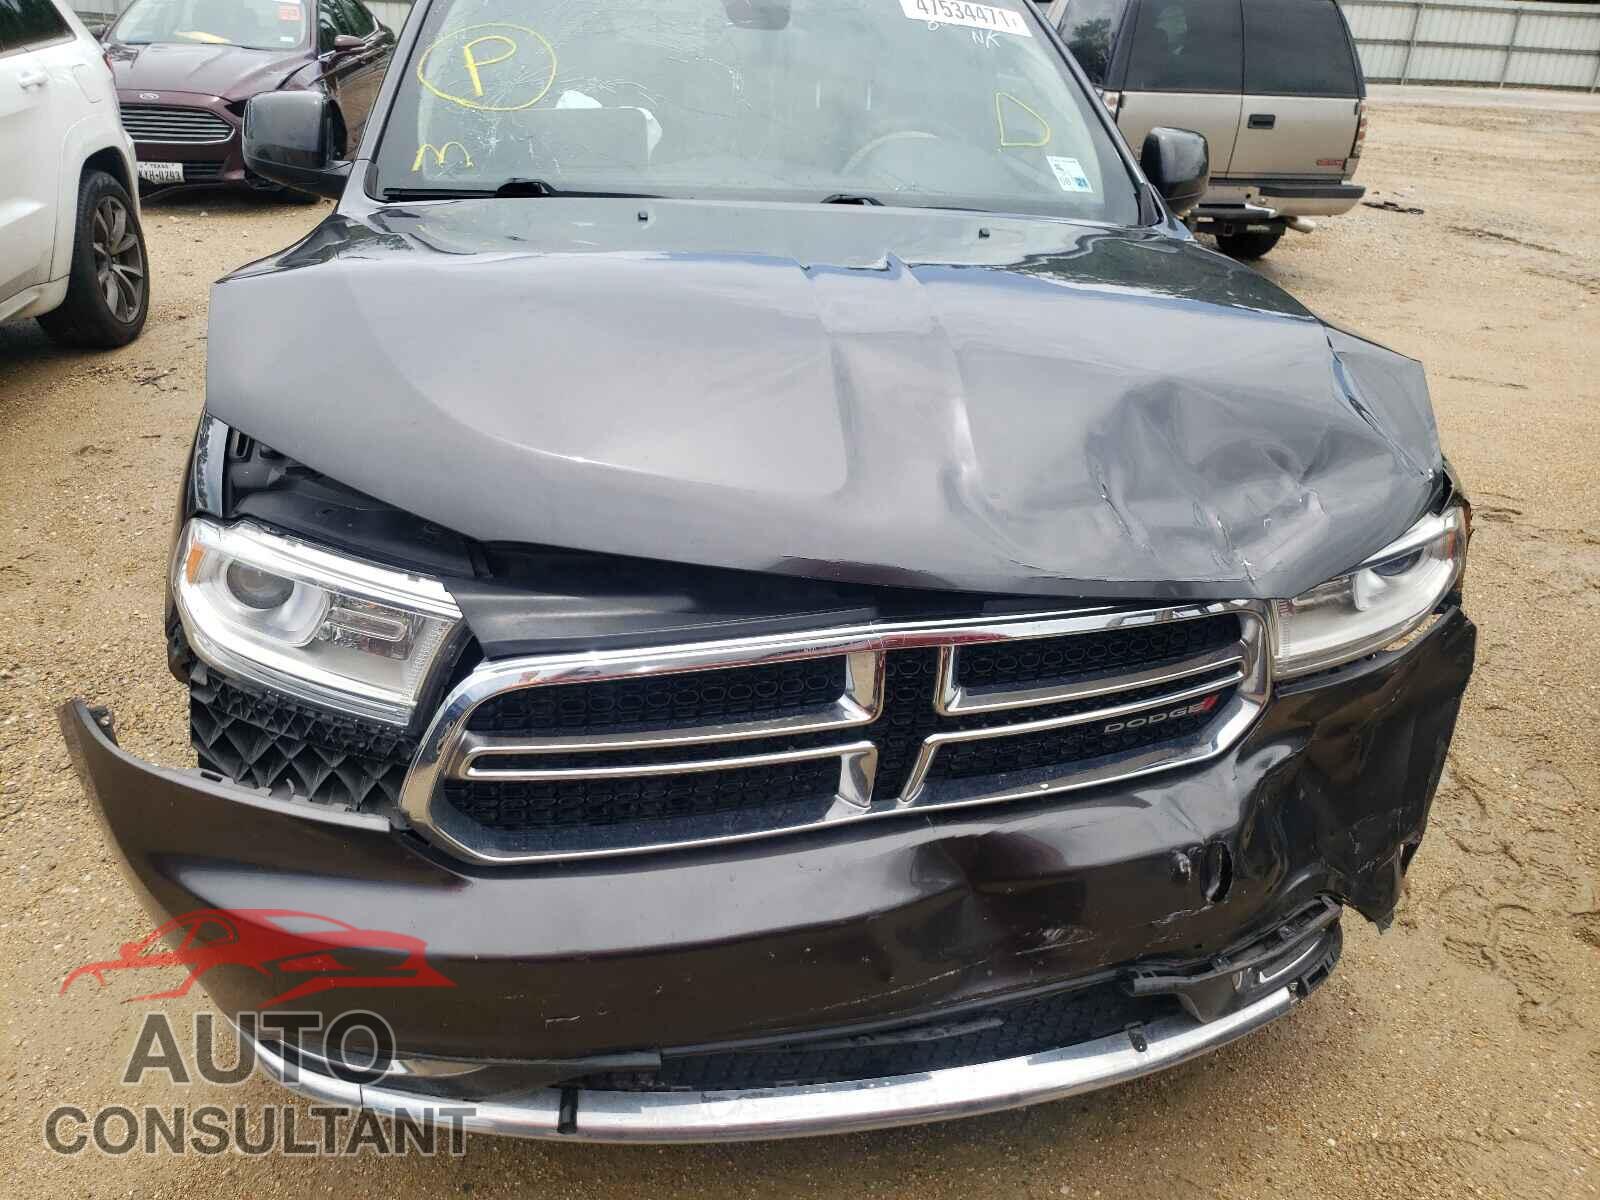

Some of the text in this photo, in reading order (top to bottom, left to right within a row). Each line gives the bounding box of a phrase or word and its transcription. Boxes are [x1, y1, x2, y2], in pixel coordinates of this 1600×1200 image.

[463, 35, 517, 97] P
[993, 91, 1050, 147] D
[1103, 703, 1205, 734] DODGE
